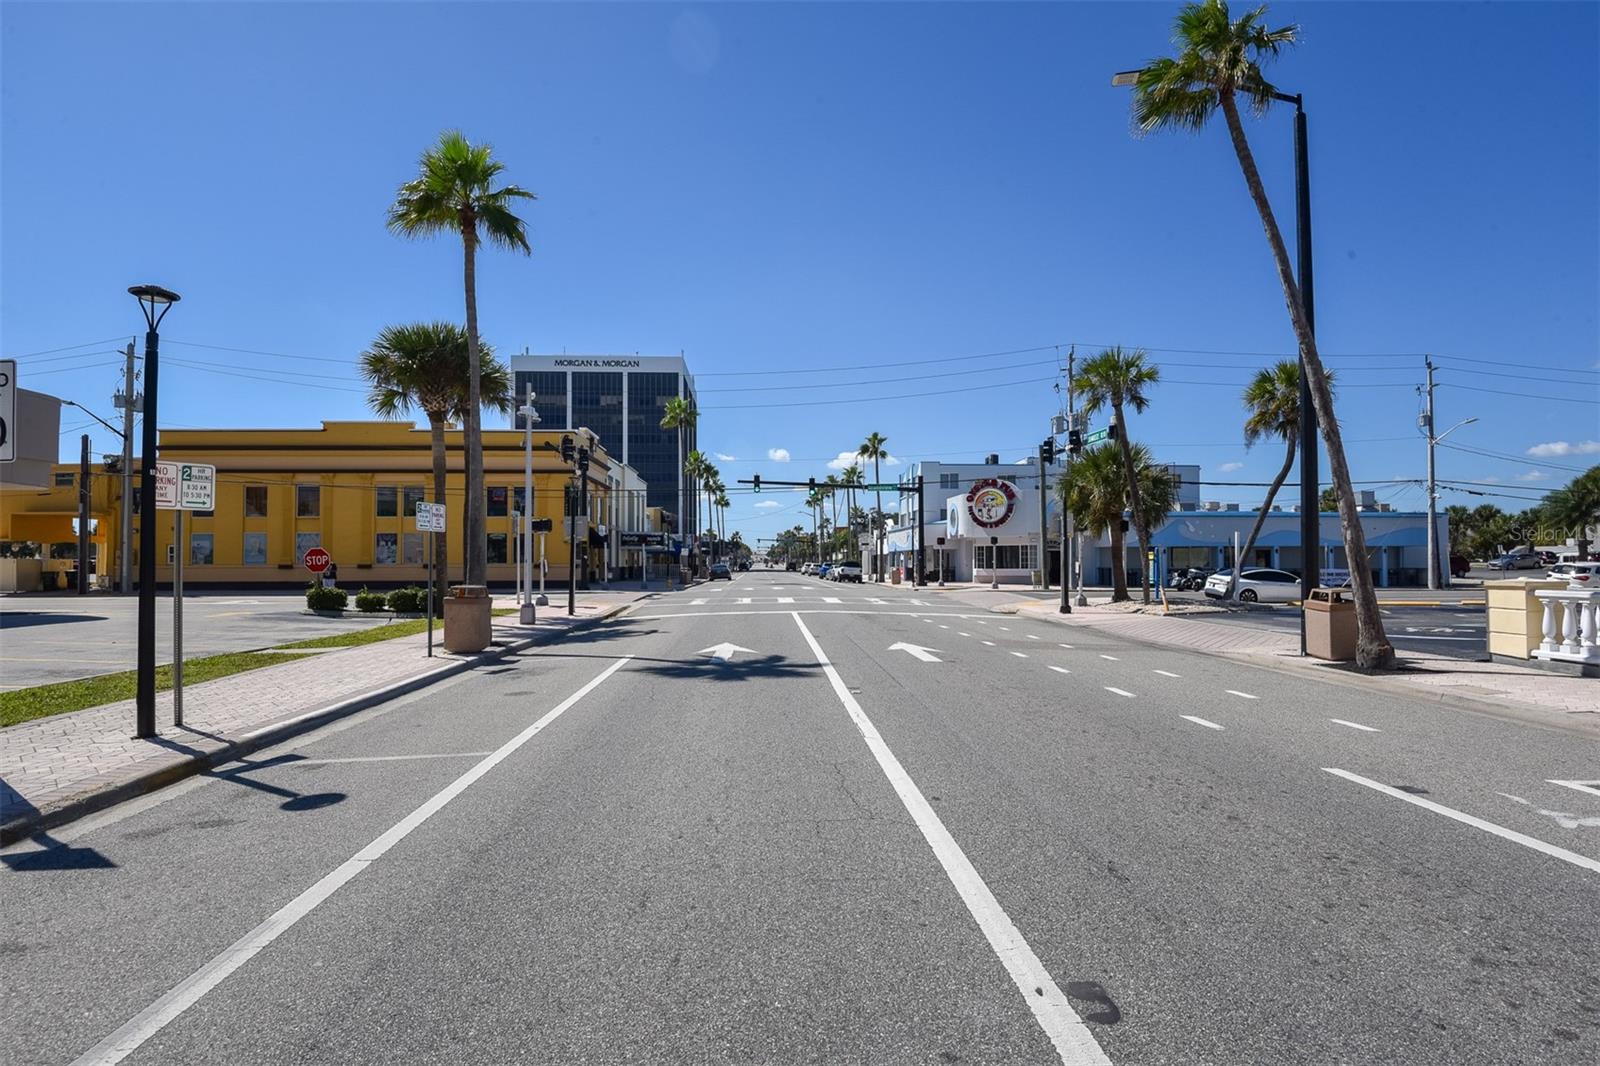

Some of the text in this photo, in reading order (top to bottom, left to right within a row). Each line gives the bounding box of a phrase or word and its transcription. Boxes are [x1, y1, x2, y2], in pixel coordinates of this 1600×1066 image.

[555, 359, 592, 367] MORGAN
[602, 360, 639, 368] MORGAN
[155, 466, 168, 475] NO
[183, 467, 191, 480] 2
[156, 476, 176, 486] RKING
[306, 555, 329, 566] STOP
